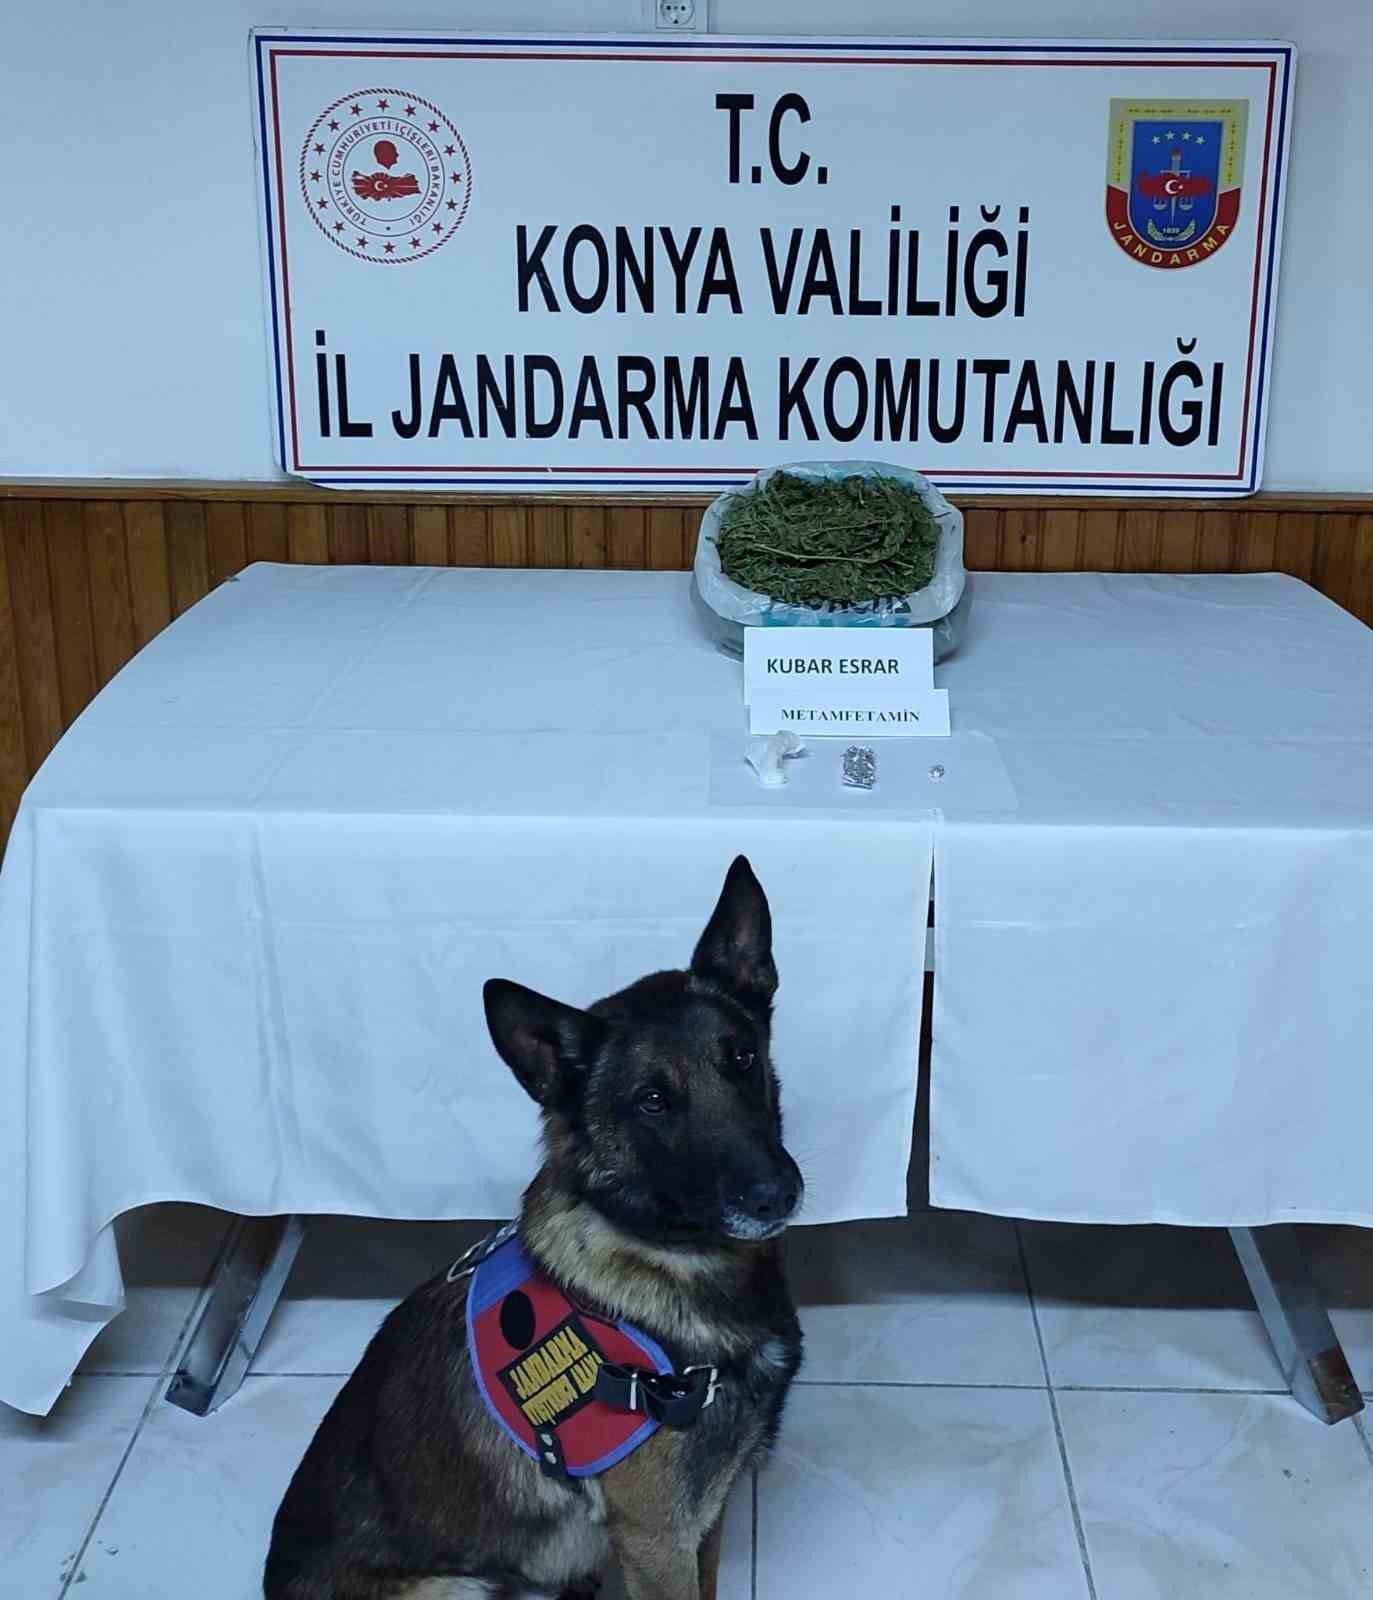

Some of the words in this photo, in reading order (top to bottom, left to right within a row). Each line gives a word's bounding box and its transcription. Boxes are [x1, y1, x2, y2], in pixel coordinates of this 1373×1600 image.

[331, 120, 392, 177] CUMHURİYETİ
[395, 121, 438, 162] İÇİŞLERİ
[715, 93, 828, 186] T.C.
[332, 181, 368, 226] TÜRKİYE
[409, 165, 441, 226] BAKANLIĞI
[516, 225, 743, 314] KONYA
[759, 205, 1030, 318] VALİLİĞİ
[1113, 222, 1230, 265] JANDARMA
[315, 329, 373, 438] İL
[391, 353, 759, 441] JANDARMA
[778, 338, 1224, 447] KOMUTANLIĞI
[766, 658, 833, 675] KUBAR
[839, 658, 900, 675] ESRAR
[780, 707, 921, 723] METAMFETAMİN
[509, 1325, 589, 1400] JANDARMA
